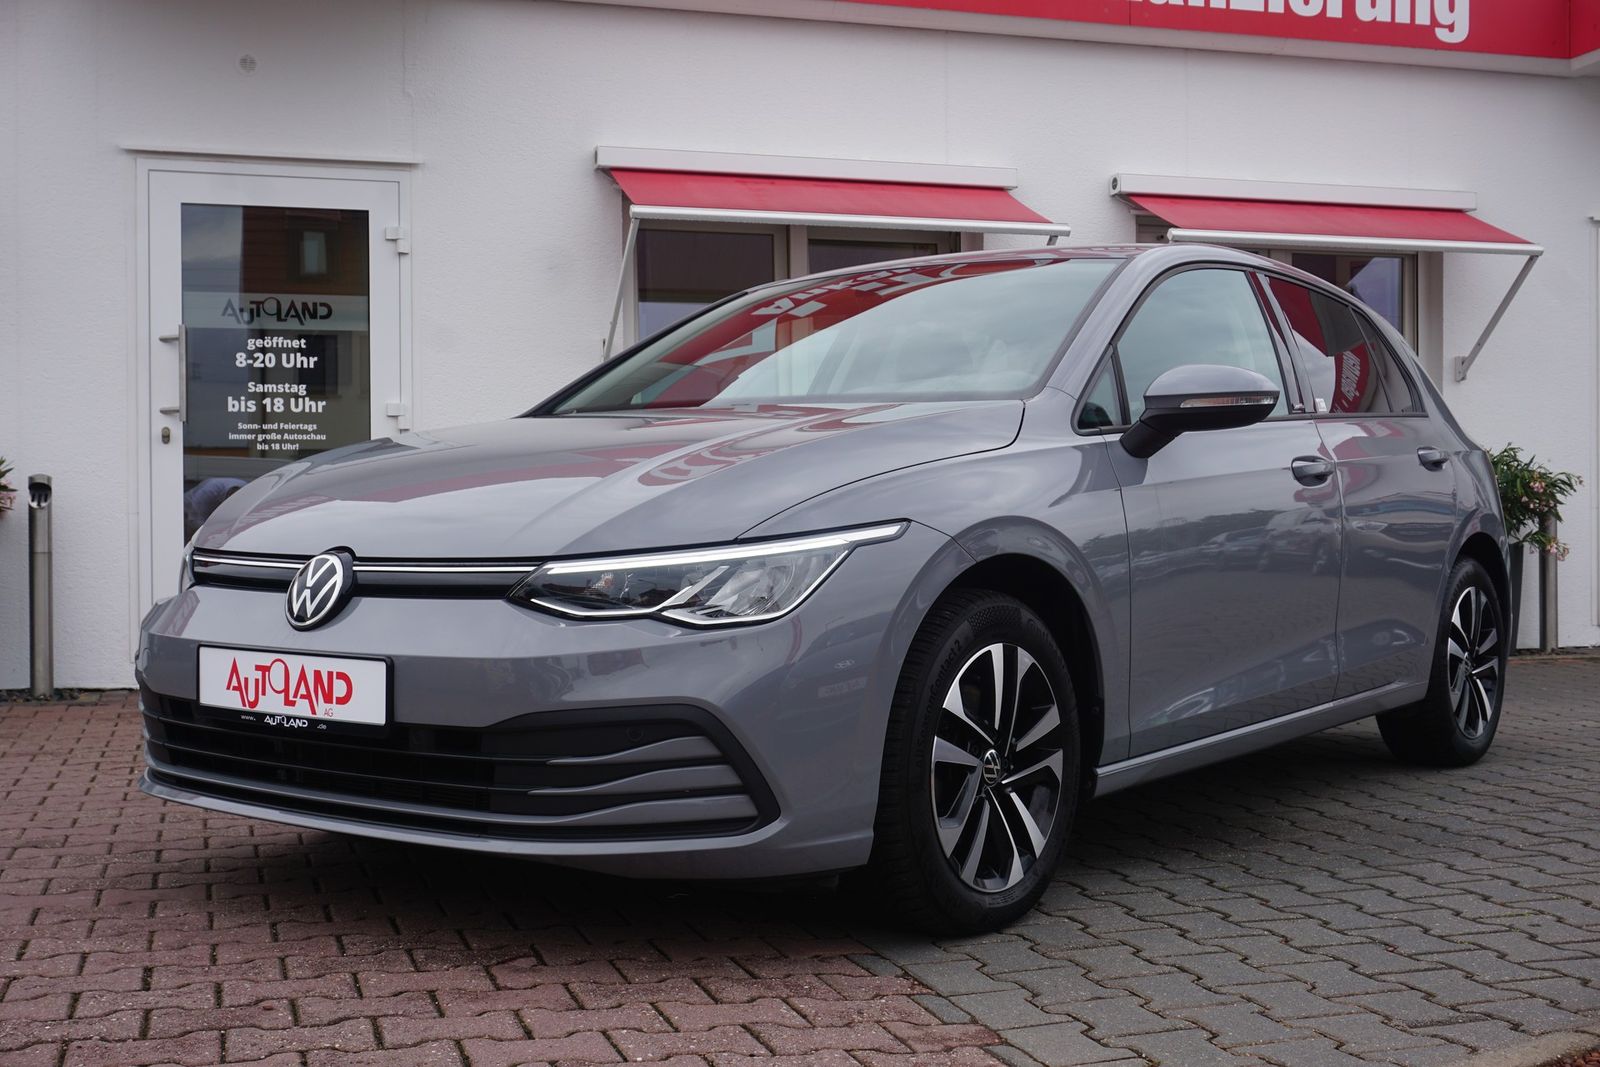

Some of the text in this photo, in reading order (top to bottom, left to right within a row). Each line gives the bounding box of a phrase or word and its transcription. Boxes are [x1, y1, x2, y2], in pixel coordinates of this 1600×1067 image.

[247, 336, 306, 350] geöffnet
[235, 352, 318, 369] 8-20 Uhr
[247, 382, 307, 396] Samstag
[227, 396, 326, 413] bis 18 Uhr
[237, 422, 317, 431] Sonn- und Feiertags
[257, 433, 281, 441] große
[283, 433, 326, 441] Autoschau
[226, 657, 353, 715] AUTOLAND
[323, 707, 334, 717] AG
